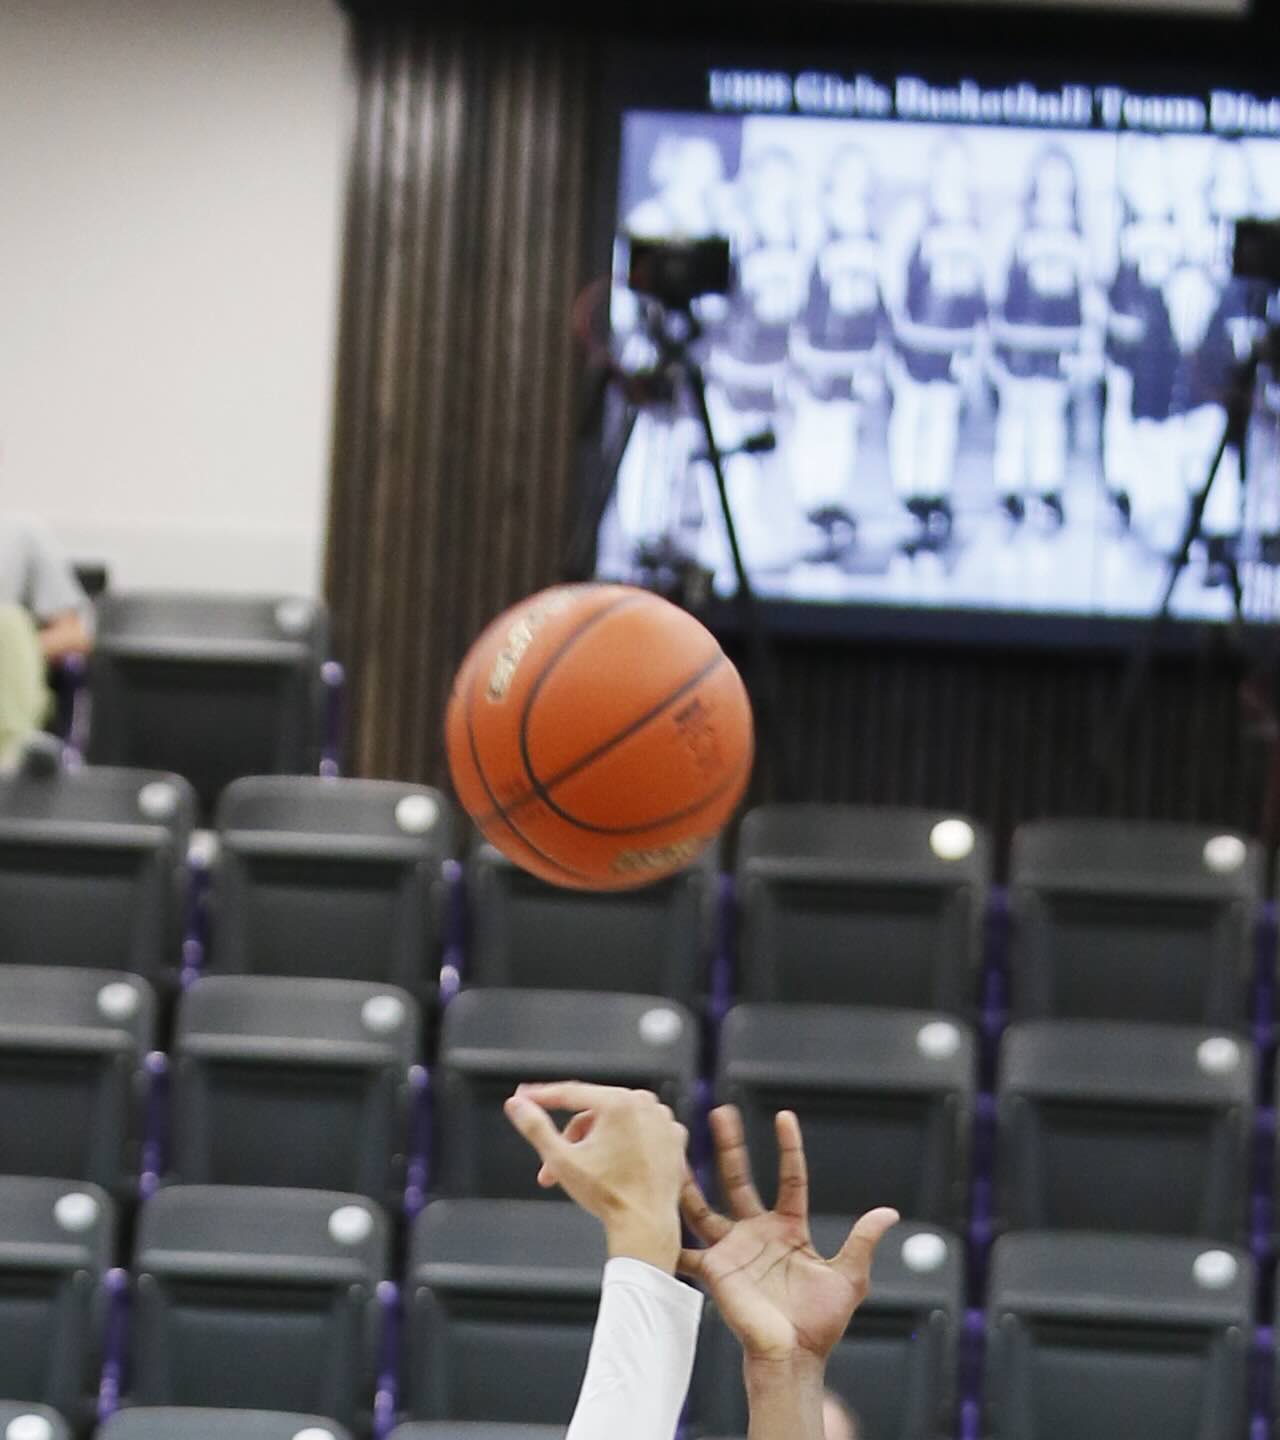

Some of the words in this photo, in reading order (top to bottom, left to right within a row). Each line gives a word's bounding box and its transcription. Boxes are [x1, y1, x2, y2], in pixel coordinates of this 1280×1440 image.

[794, 70, 890, 116] Girls
[895, 76, 1092, 127] Basketball
[1094, 86, 1205, 129] Team
